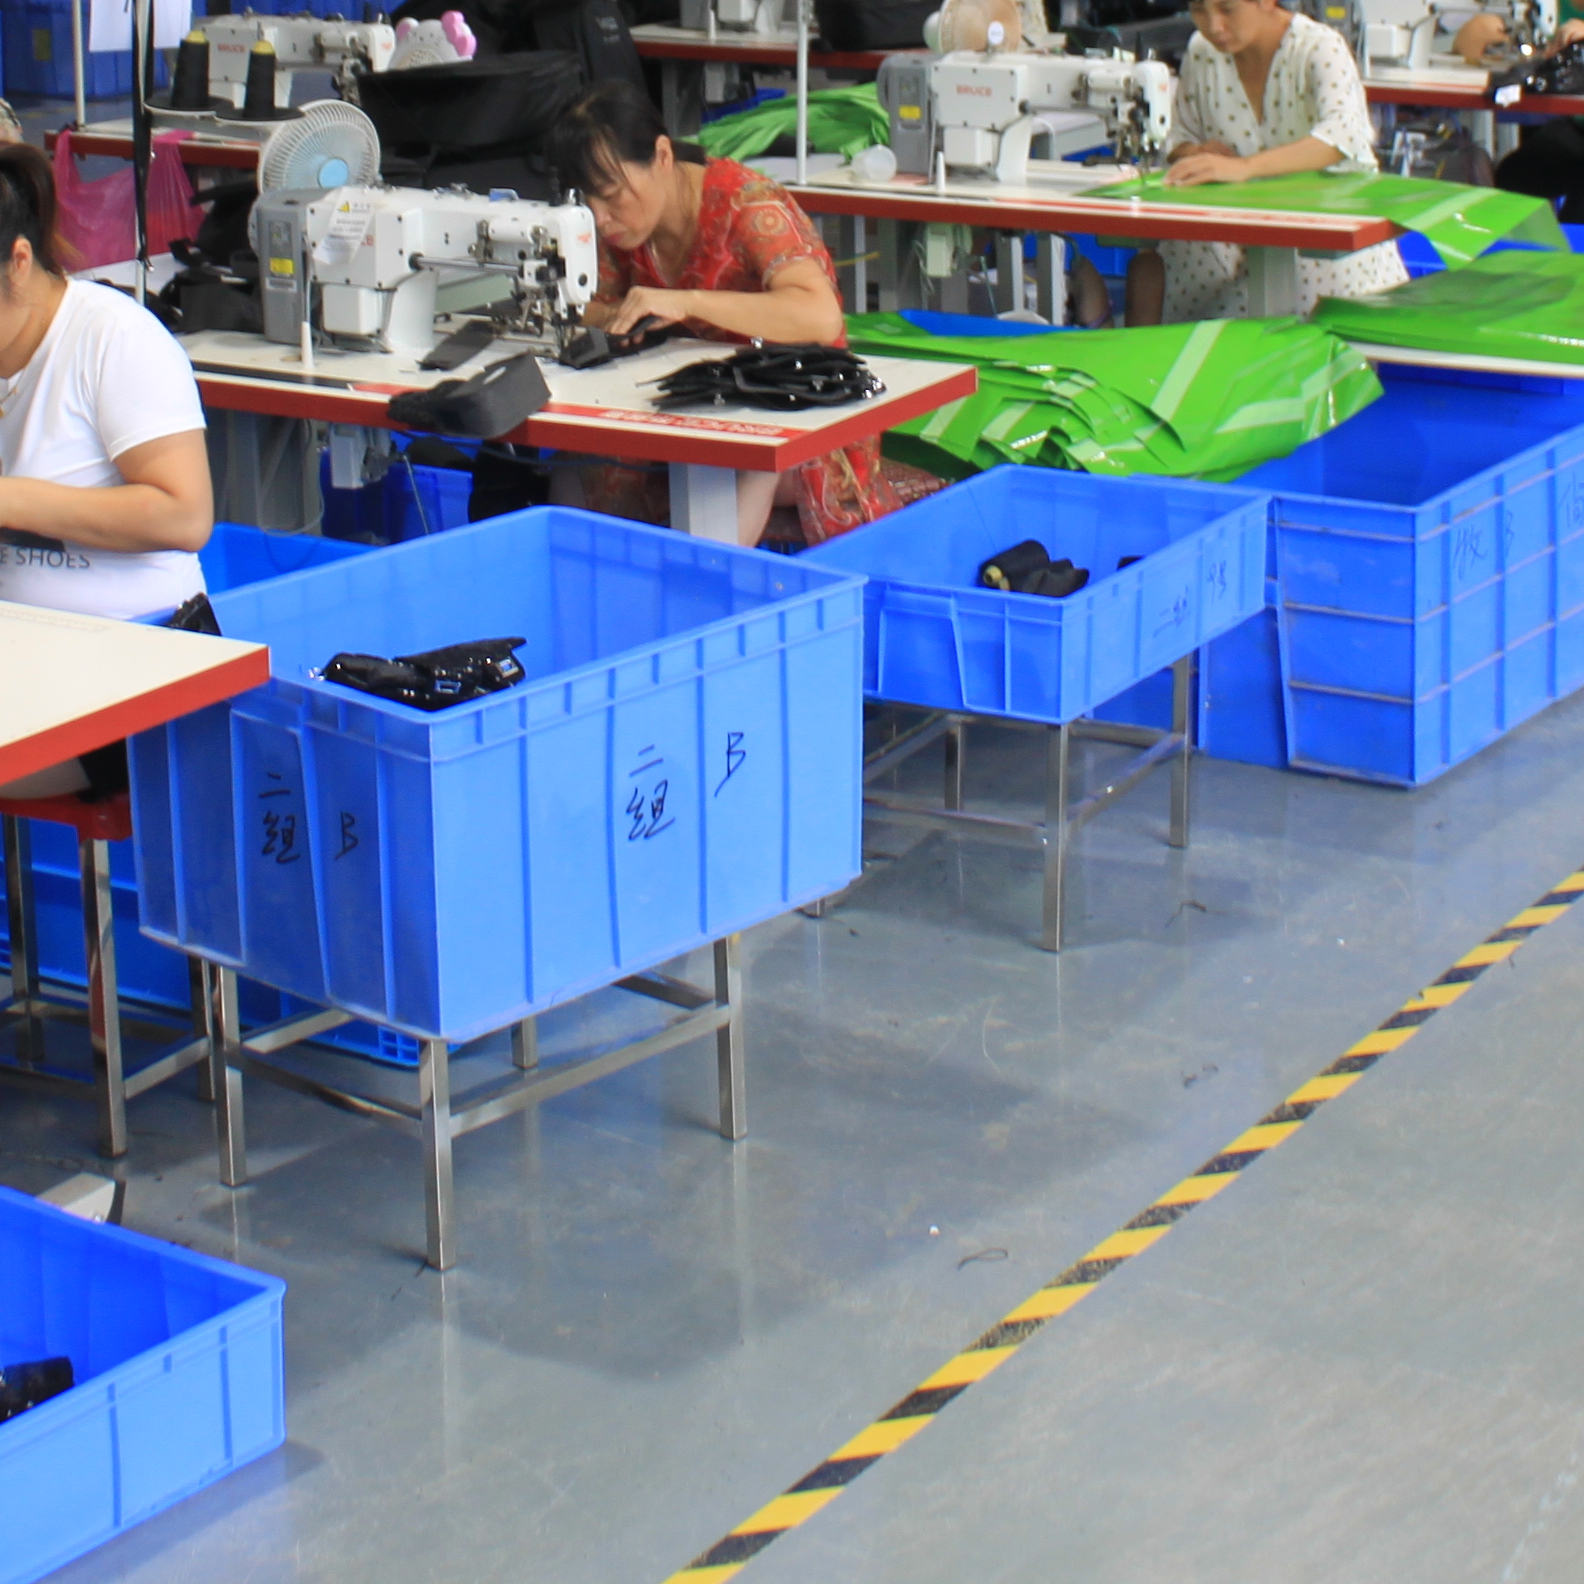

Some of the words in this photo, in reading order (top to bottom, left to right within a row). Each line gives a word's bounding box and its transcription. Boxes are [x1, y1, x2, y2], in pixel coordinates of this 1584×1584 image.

[16, 546, 90, 569] SHOES
[258, 772, 301, 864] 二组
[335, 811, 359, 861] B
[625, 744, 676, 841] 二组
[715, 731, 746, 798] B
